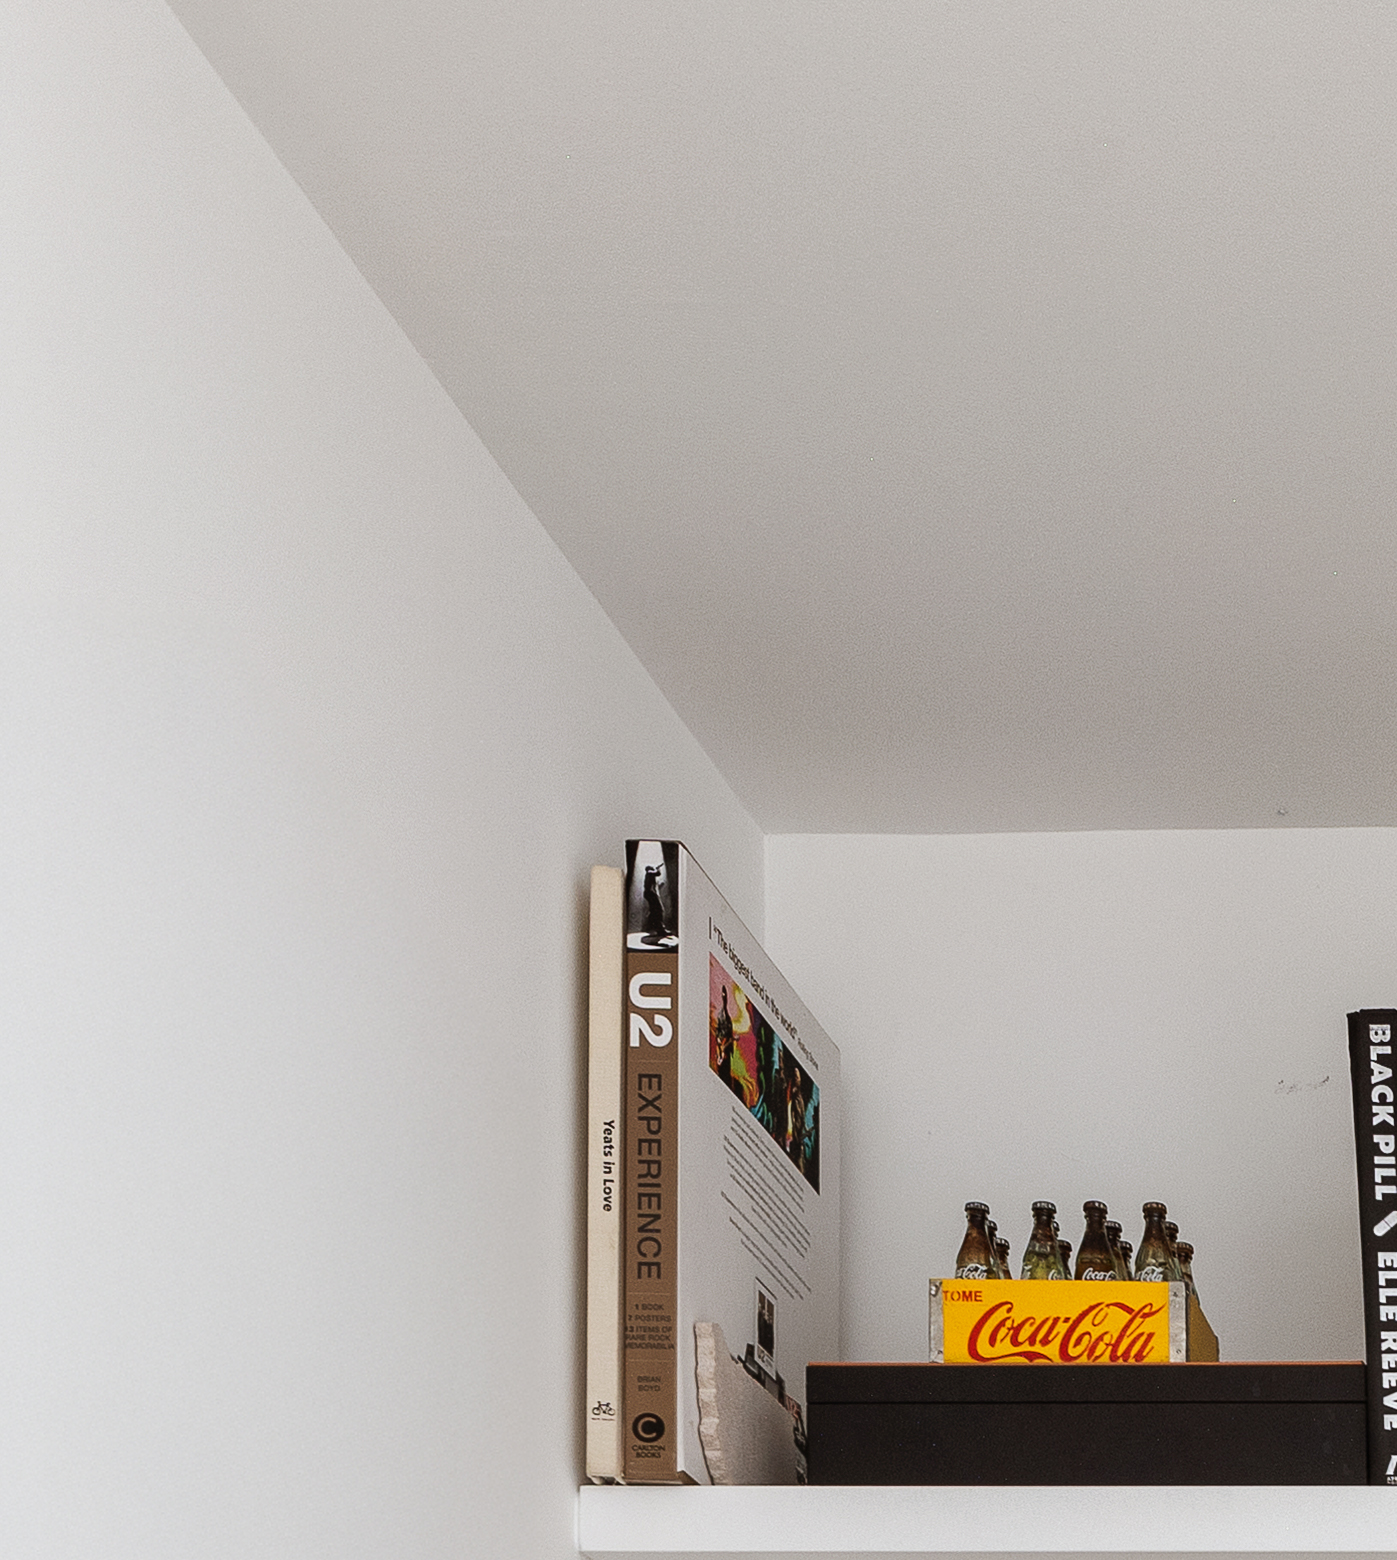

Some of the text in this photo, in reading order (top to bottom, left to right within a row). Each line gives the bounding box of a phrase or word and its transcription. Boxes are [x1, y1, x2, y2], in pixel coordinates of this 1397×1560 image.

[629, 971, 672, 1049] U2
[1369, 1024, 1397, 1200] BLACK PILL
[602, 1119, 616, 1213] Yeats in Love
[637, 1072, 661, 1280] EXPERIENCE
[968, 1302, 1166, 1362] Coca-Cola
[631, 1443, 665, 1453] CARLTON
[635, 1451, 662, 1460] BOOKS
